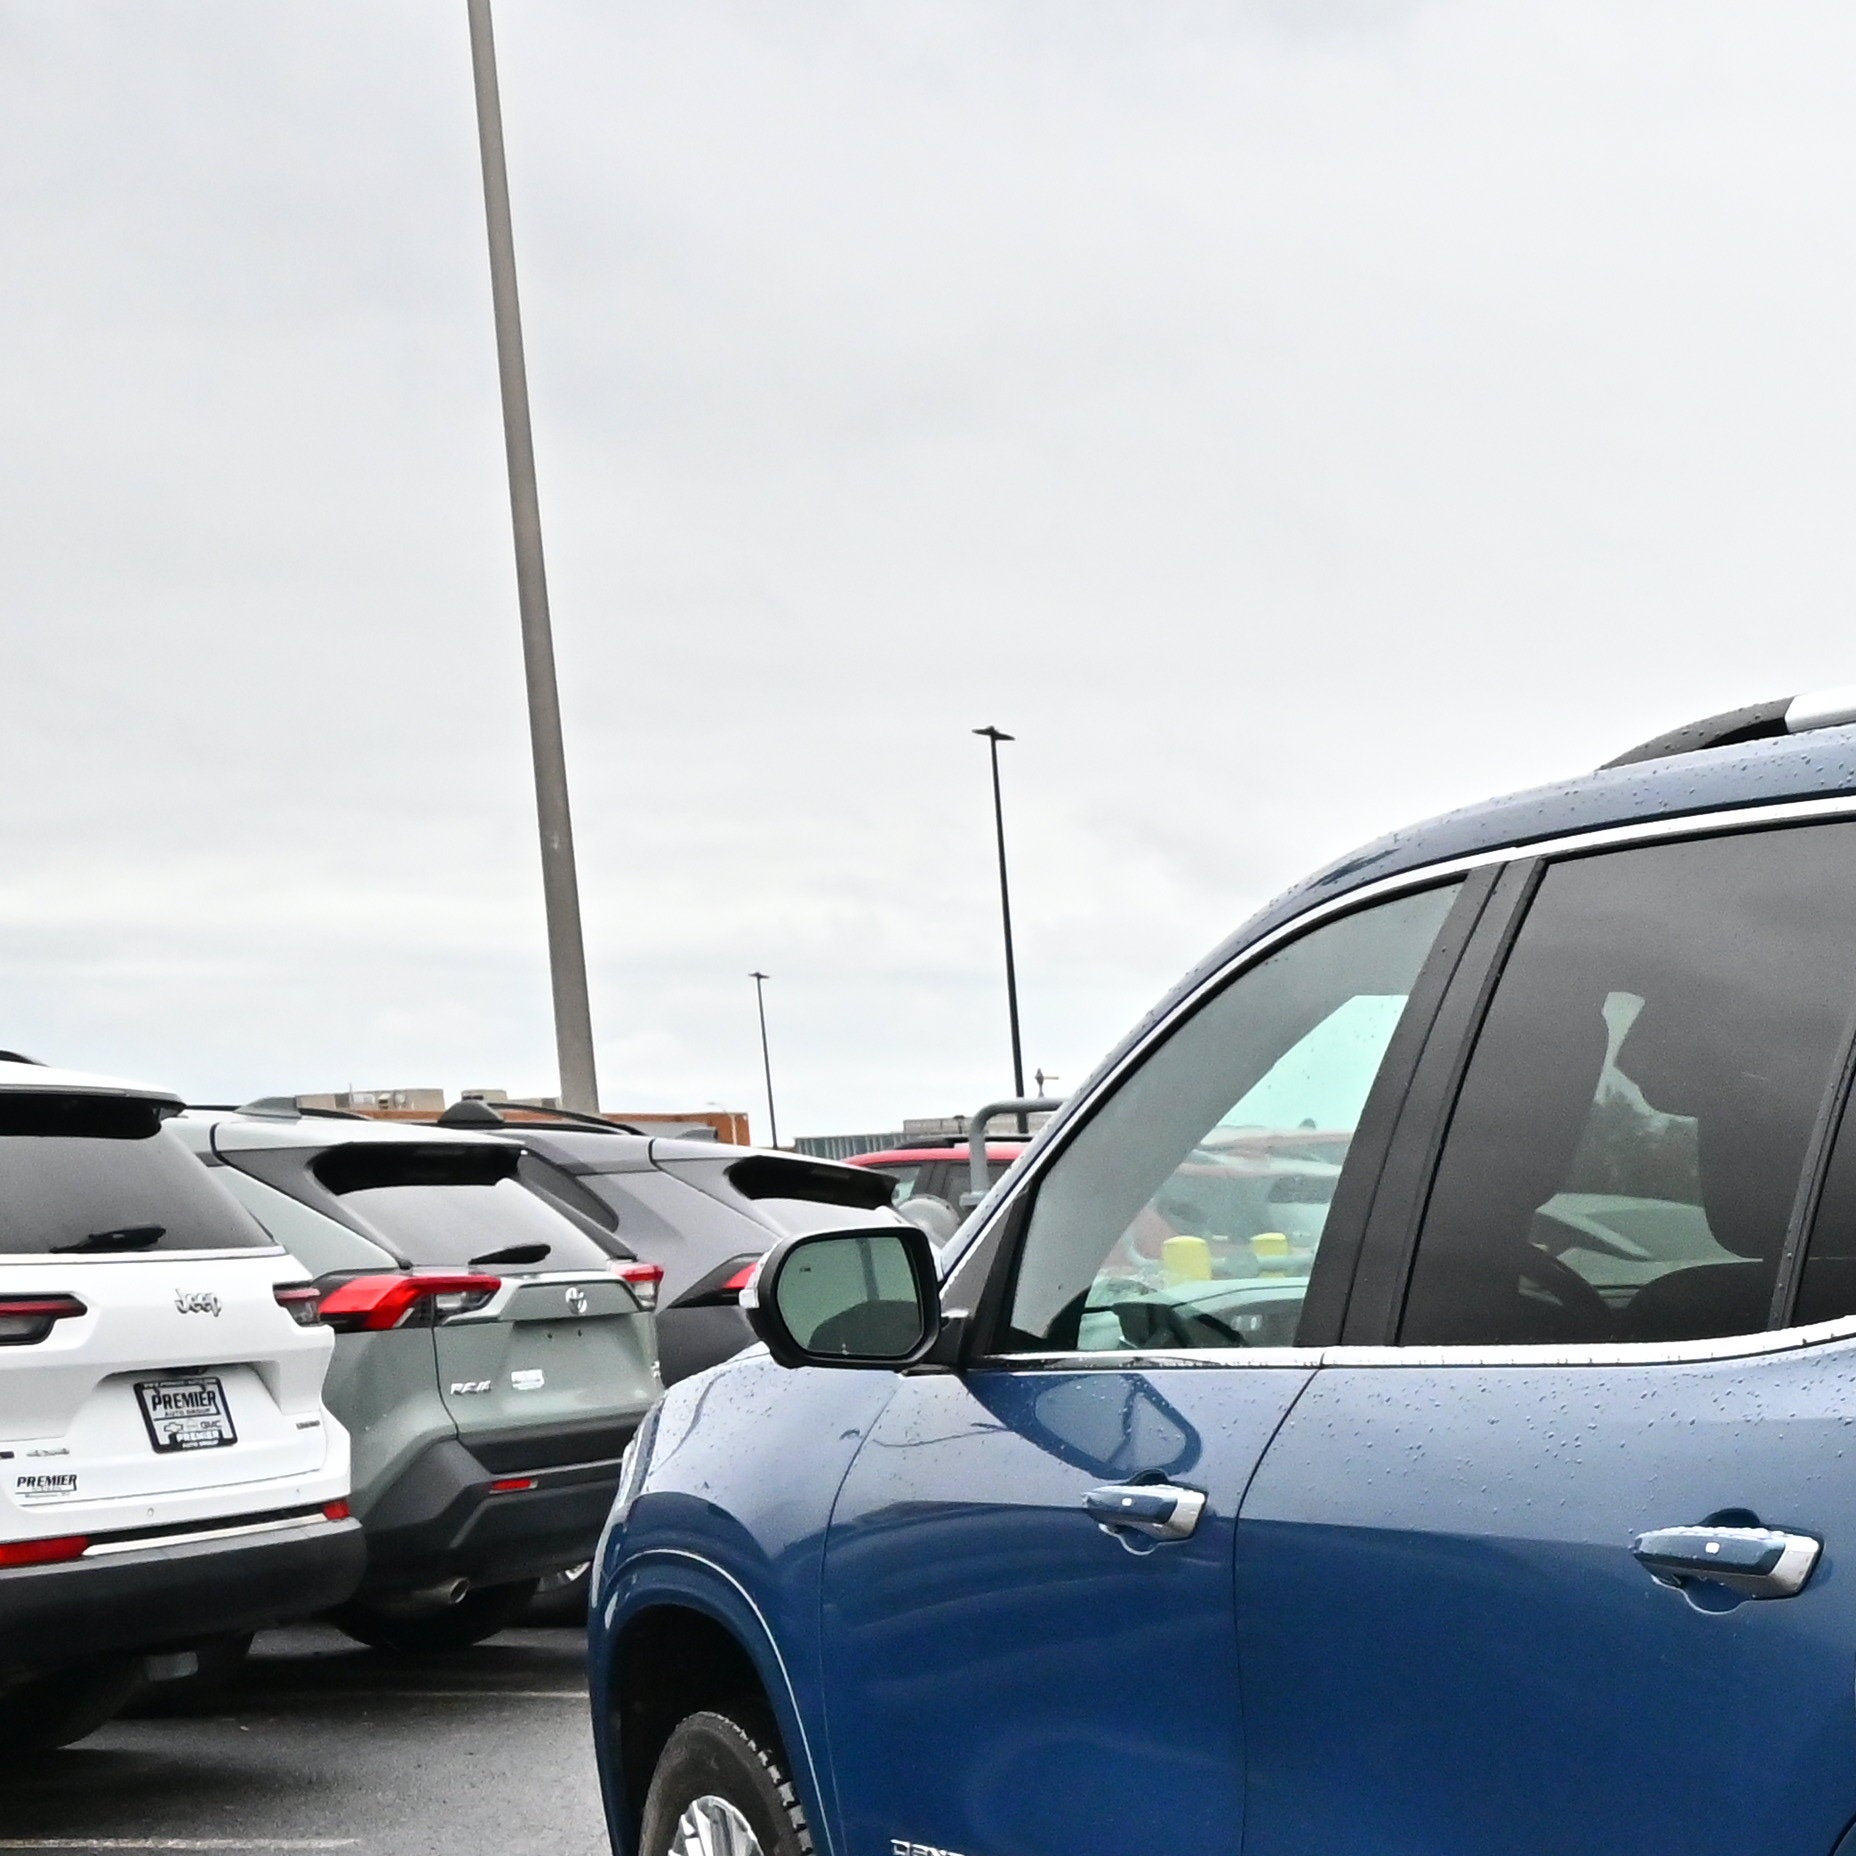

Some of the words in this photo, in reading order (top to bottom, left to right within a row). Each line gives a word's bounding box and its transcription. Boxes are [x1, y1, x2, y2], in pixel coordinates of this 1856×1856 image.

[174, 1288, 221, 1317] Jeep
[151, 1390, 217, 1412] PREMIER
[16, 1474, 77, 1488] PREMIER
